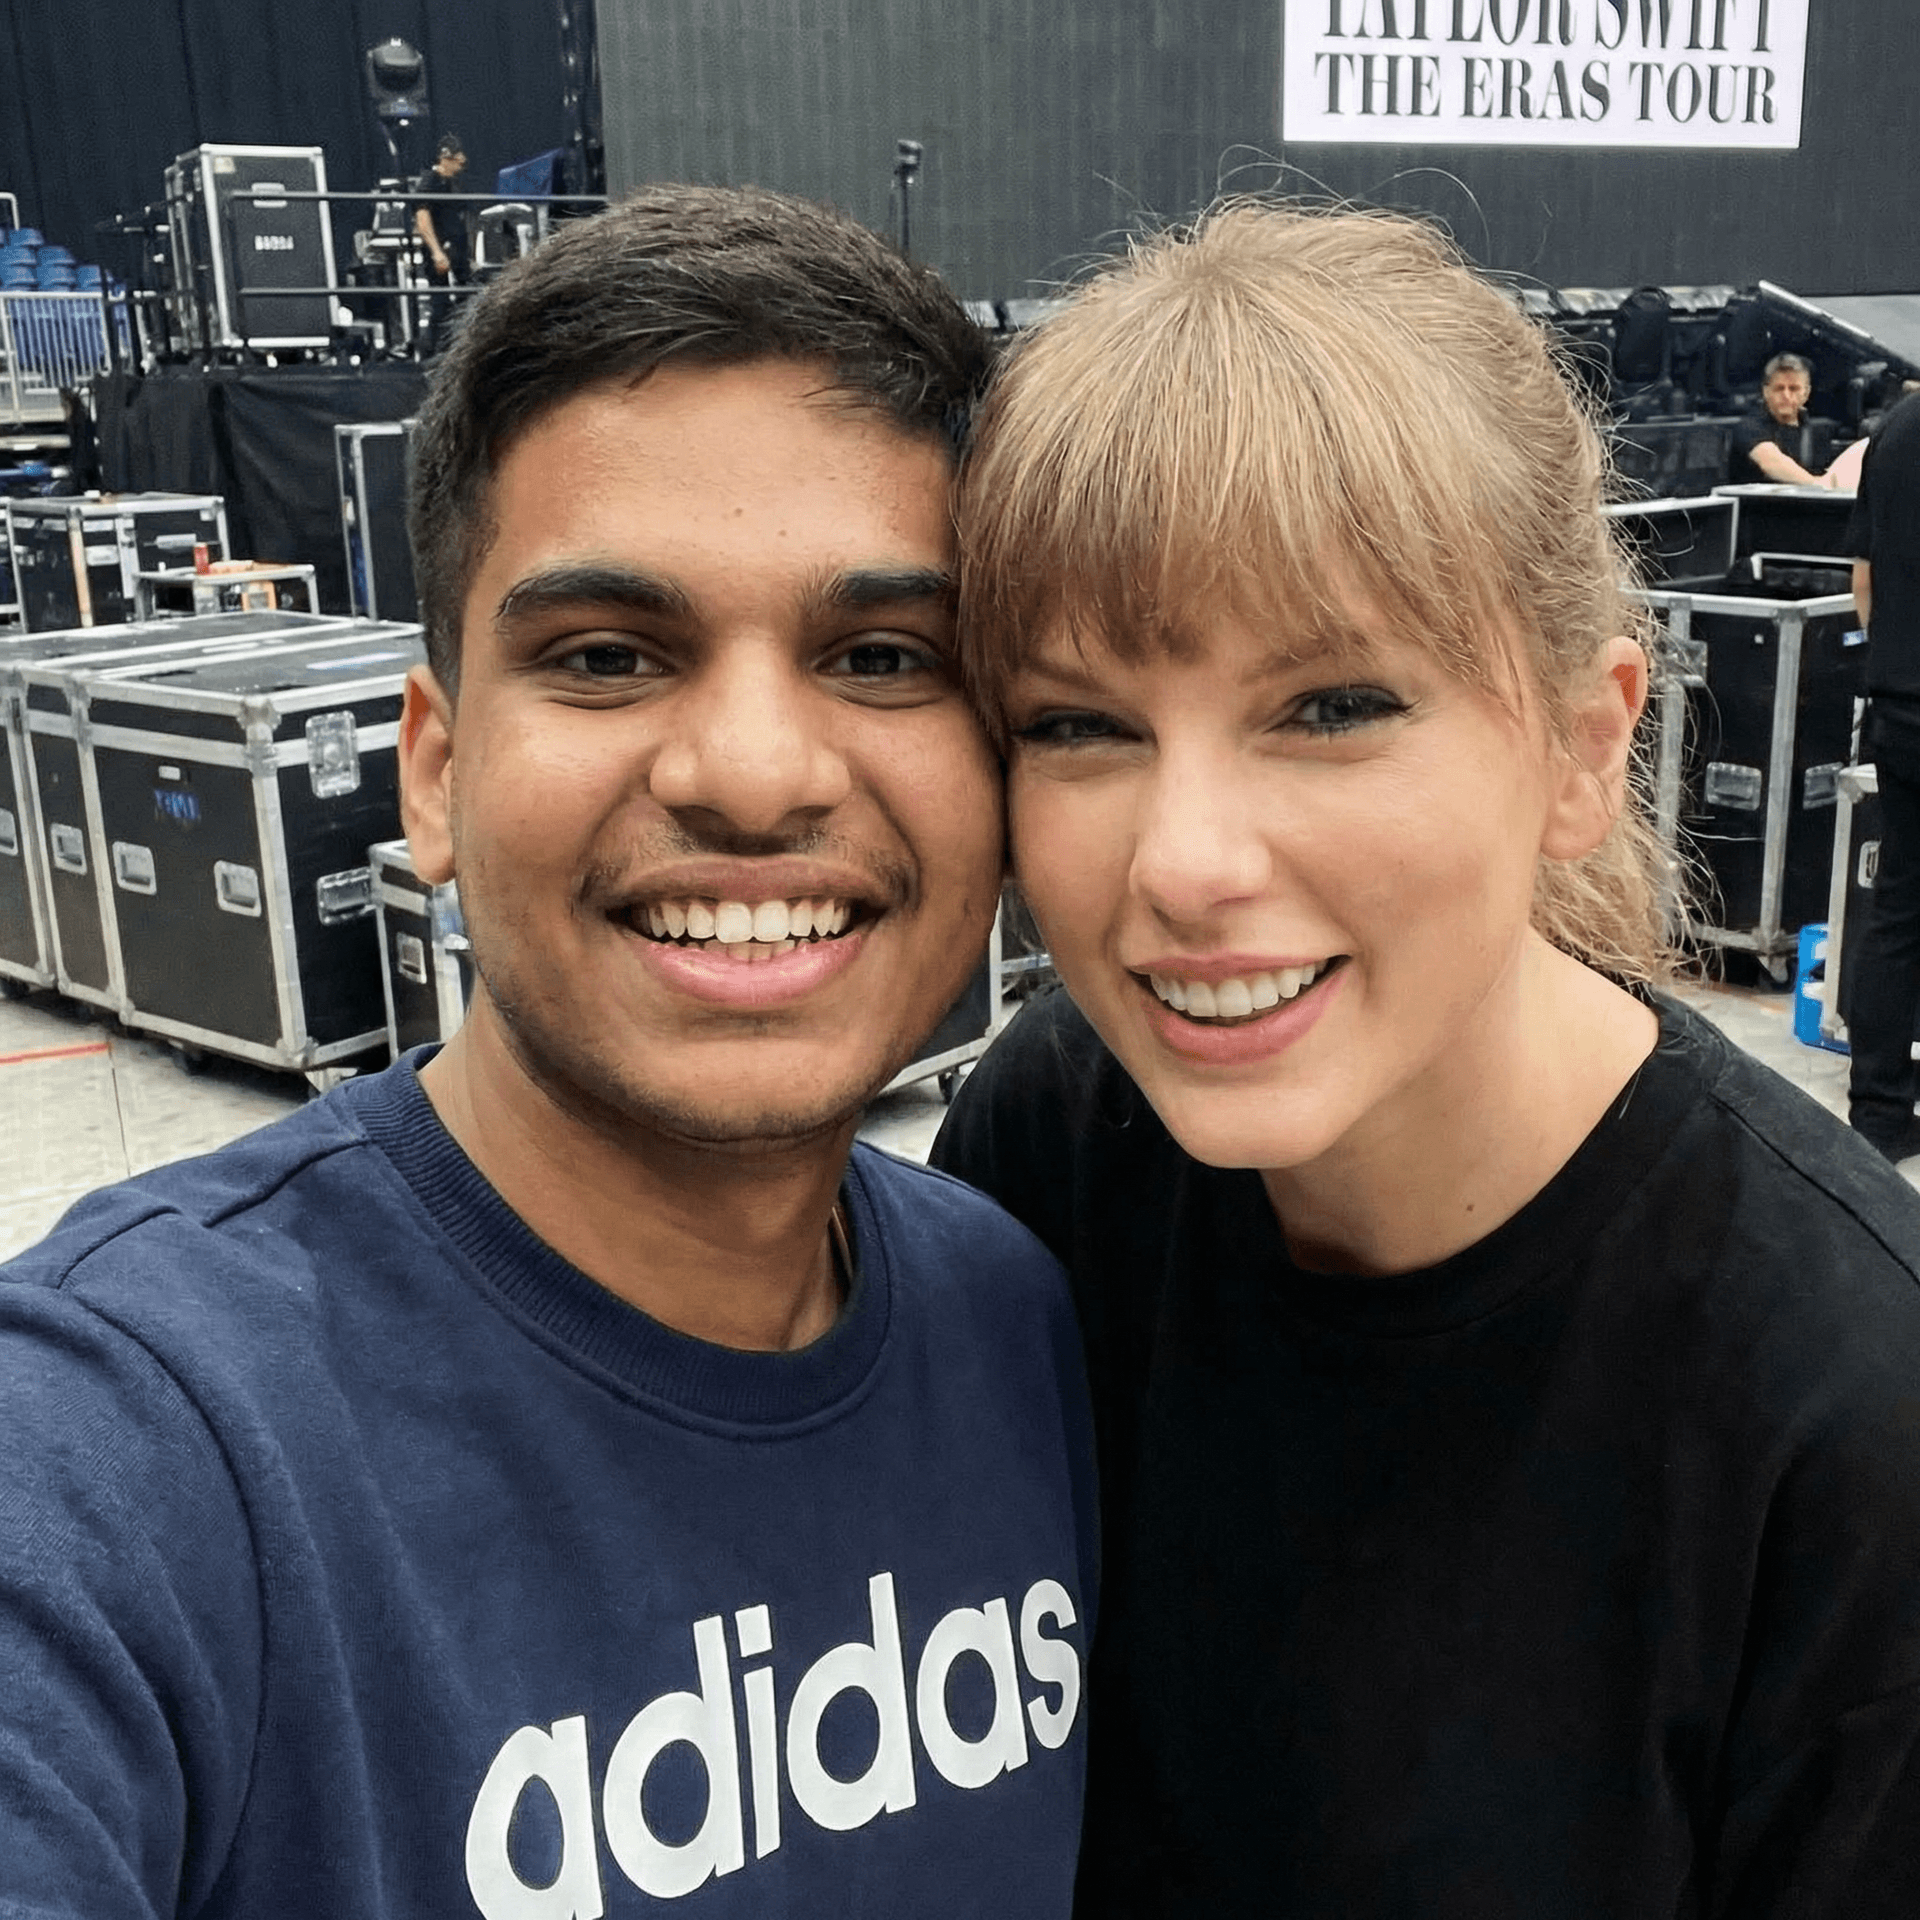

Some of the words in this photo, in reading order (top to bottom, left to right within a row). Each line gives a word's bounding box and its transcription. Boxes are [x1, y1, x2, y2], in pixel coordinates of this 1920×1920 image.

[1315, 52, 1441, 116] THE
[1459, 57, 1611, 122] ERAS
[1629, 62, 1779, 124] TOUR
[465, 1571, 1081, 1920] adidas
